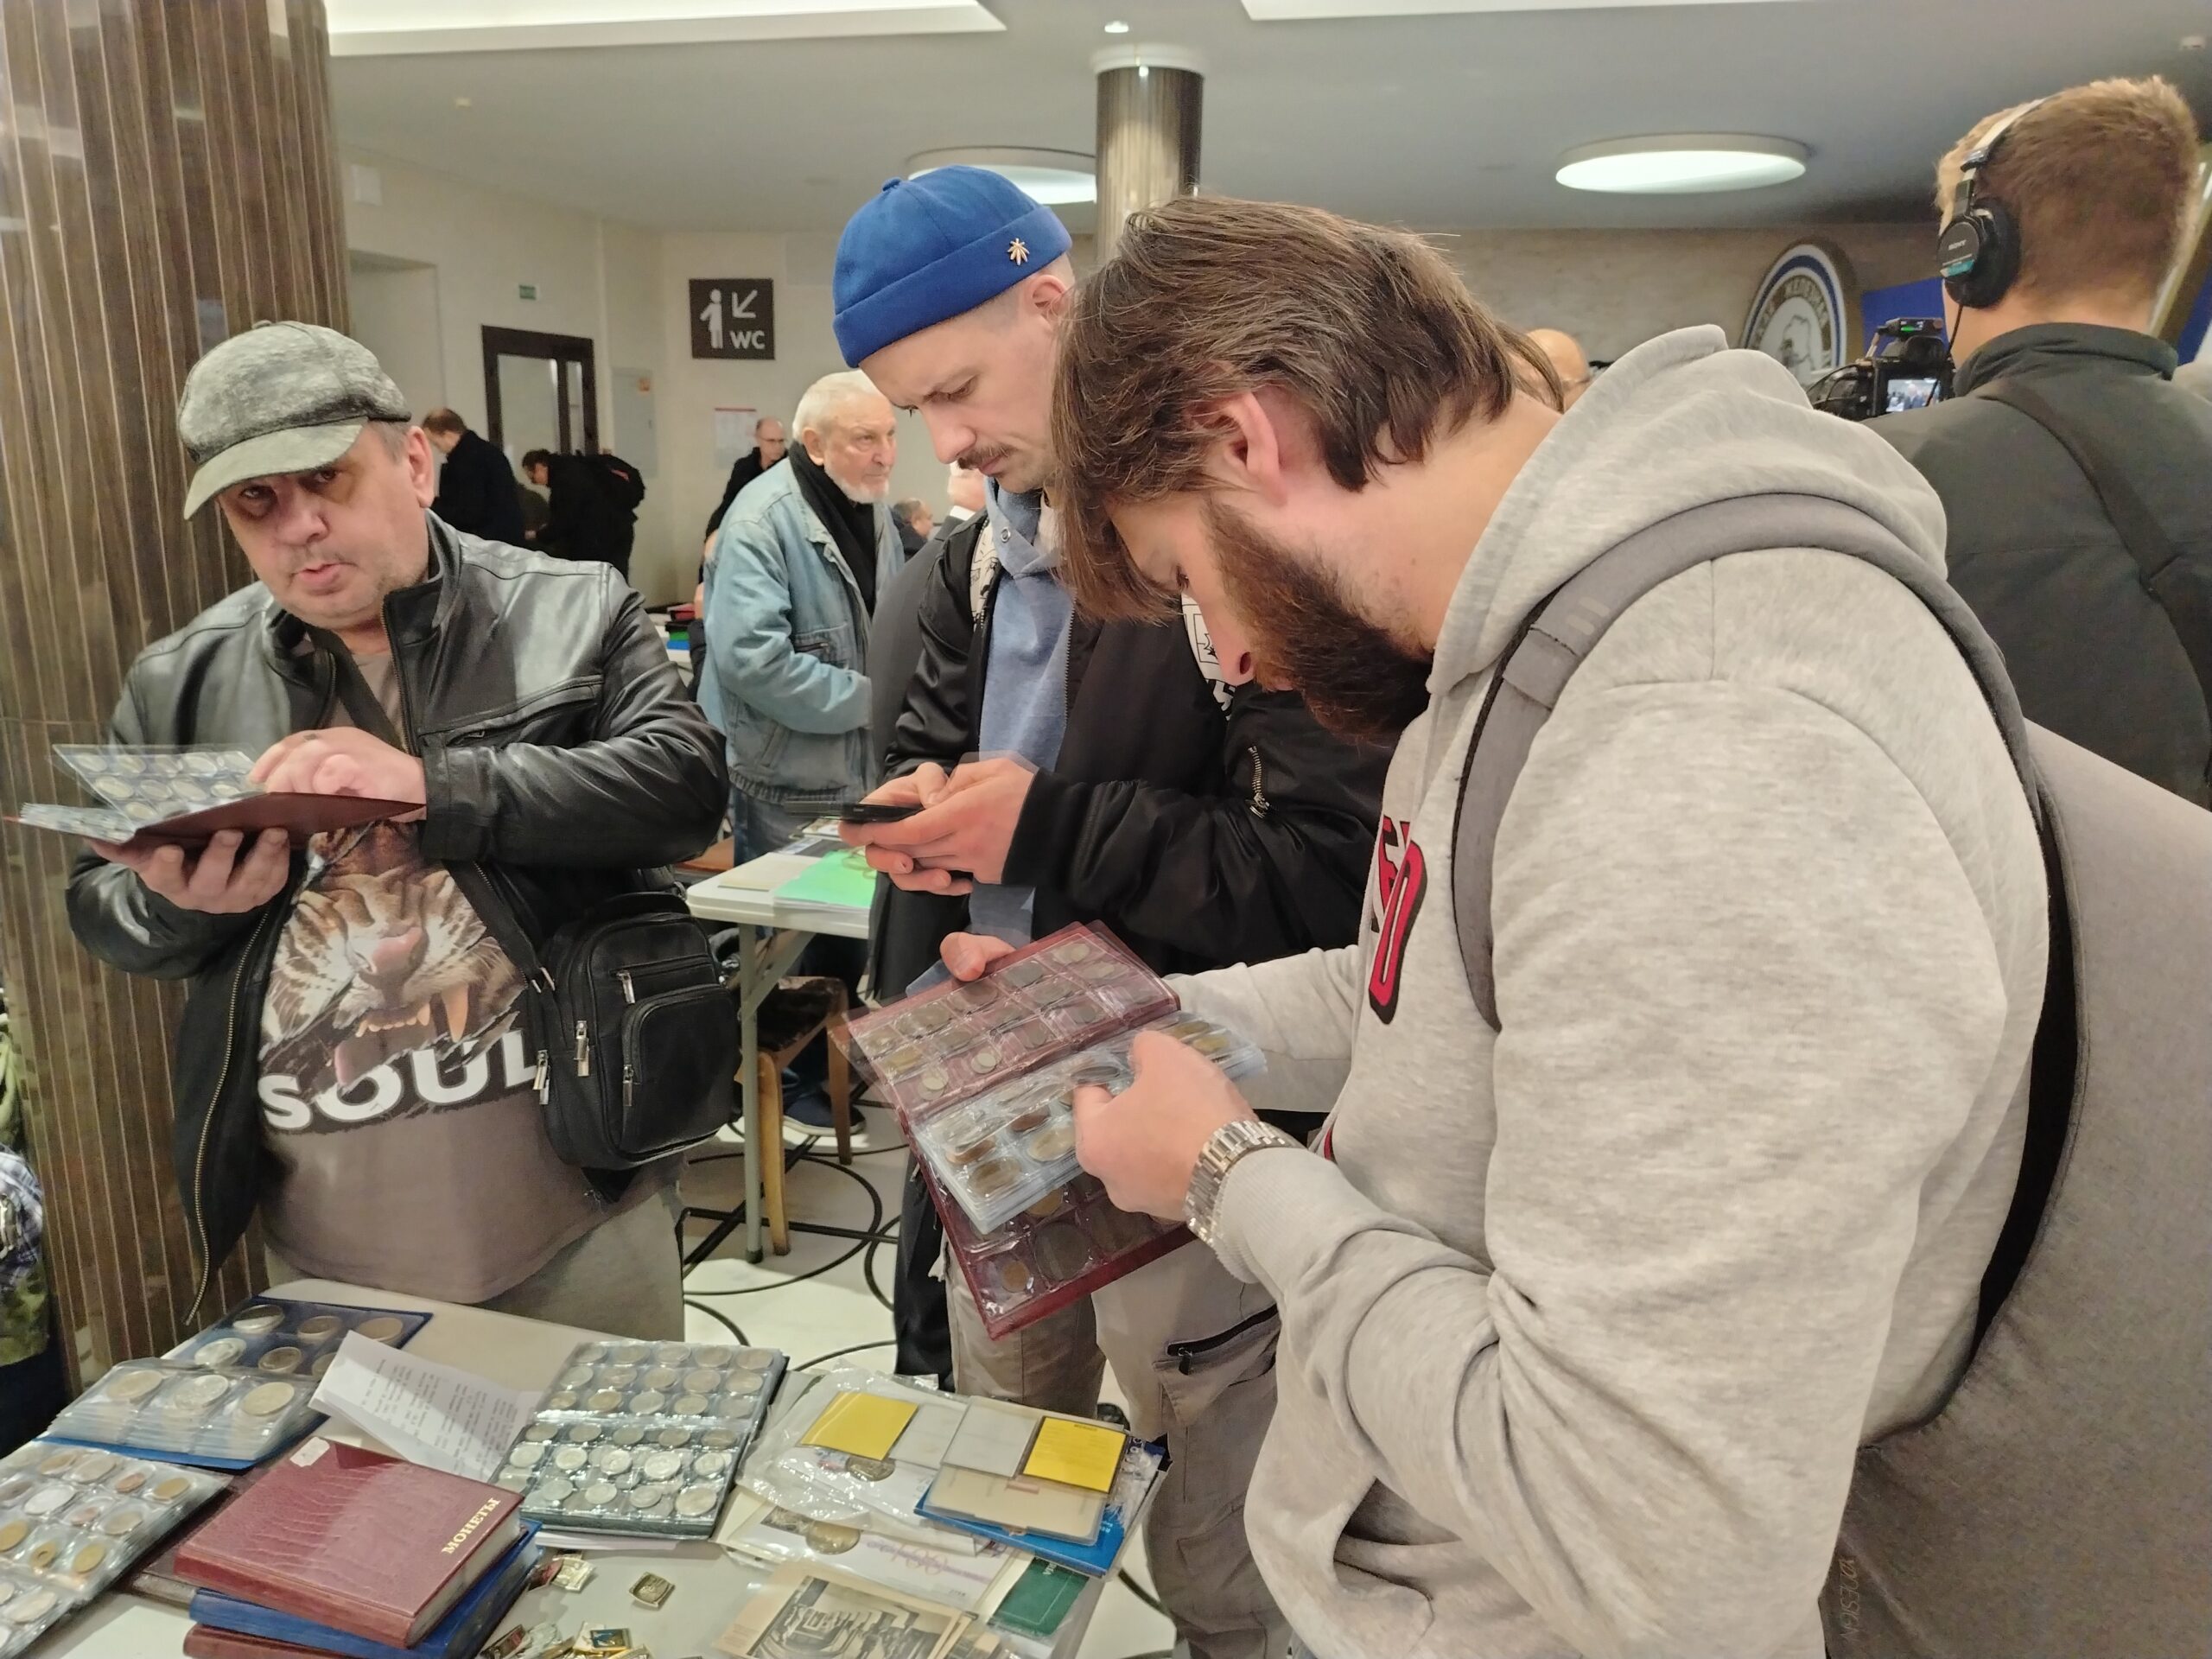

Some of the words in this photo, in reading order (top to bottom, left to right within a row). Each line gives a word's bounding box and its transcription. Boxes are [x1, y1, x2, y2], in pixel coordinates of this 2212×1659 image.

[729, 330, 766, 349] WC
[257, 1029, 537, 1128] SOUL
[441, 1497, 501, 1554] МОНЕТЫ
